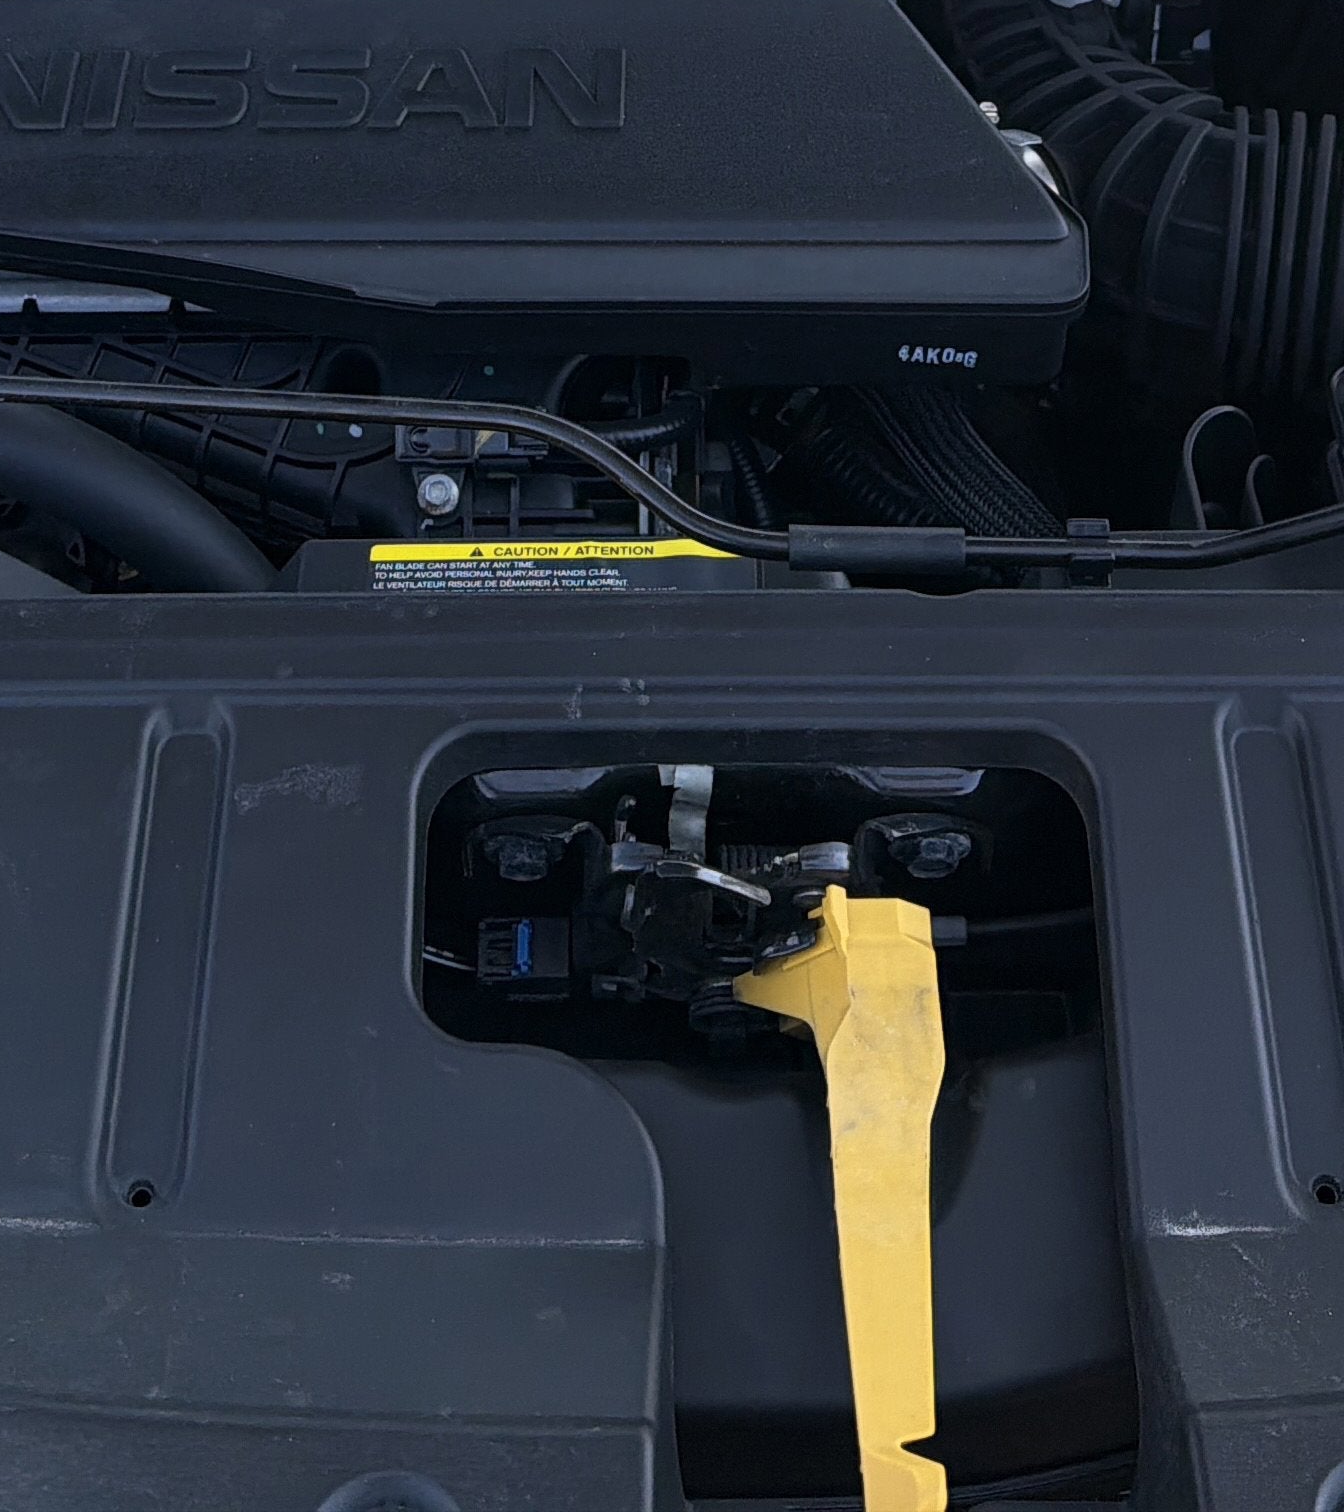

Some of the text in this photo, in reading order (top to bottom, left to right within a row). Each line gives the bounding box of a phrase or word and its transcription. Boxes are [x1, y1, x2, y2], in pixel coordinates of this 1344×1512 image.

[493, 546, 559, 557] CAUTION
[574, 545, 655, 556] ATTENTION
[375, 562, 393, 571] FAN
[394, 562, 425, 570] BLADE
[427, 562, 448, 570] CAN
[449, 561, 477, 570] START
[479, 561, 491, 569] AT
[492, 561, 512, 569] ANY
[375, 571, 387, 580] TO
[388, 571, 413, 579] HELP
[414, 571, 443, 579] AVOID
[444, 570, 495, 578] PERSONAL
[553, 568, 587, 577] HANDS
[372, 582, 385, 590] LE
[386, 581, 447, 589] VENTILATEUR
[447, 580, 483, 588] RISQUE
[484, 580, 498, 588] DE
[499, 577, 551, 587] DÉMARRER
[561, 579, 586, 587] TOUT
